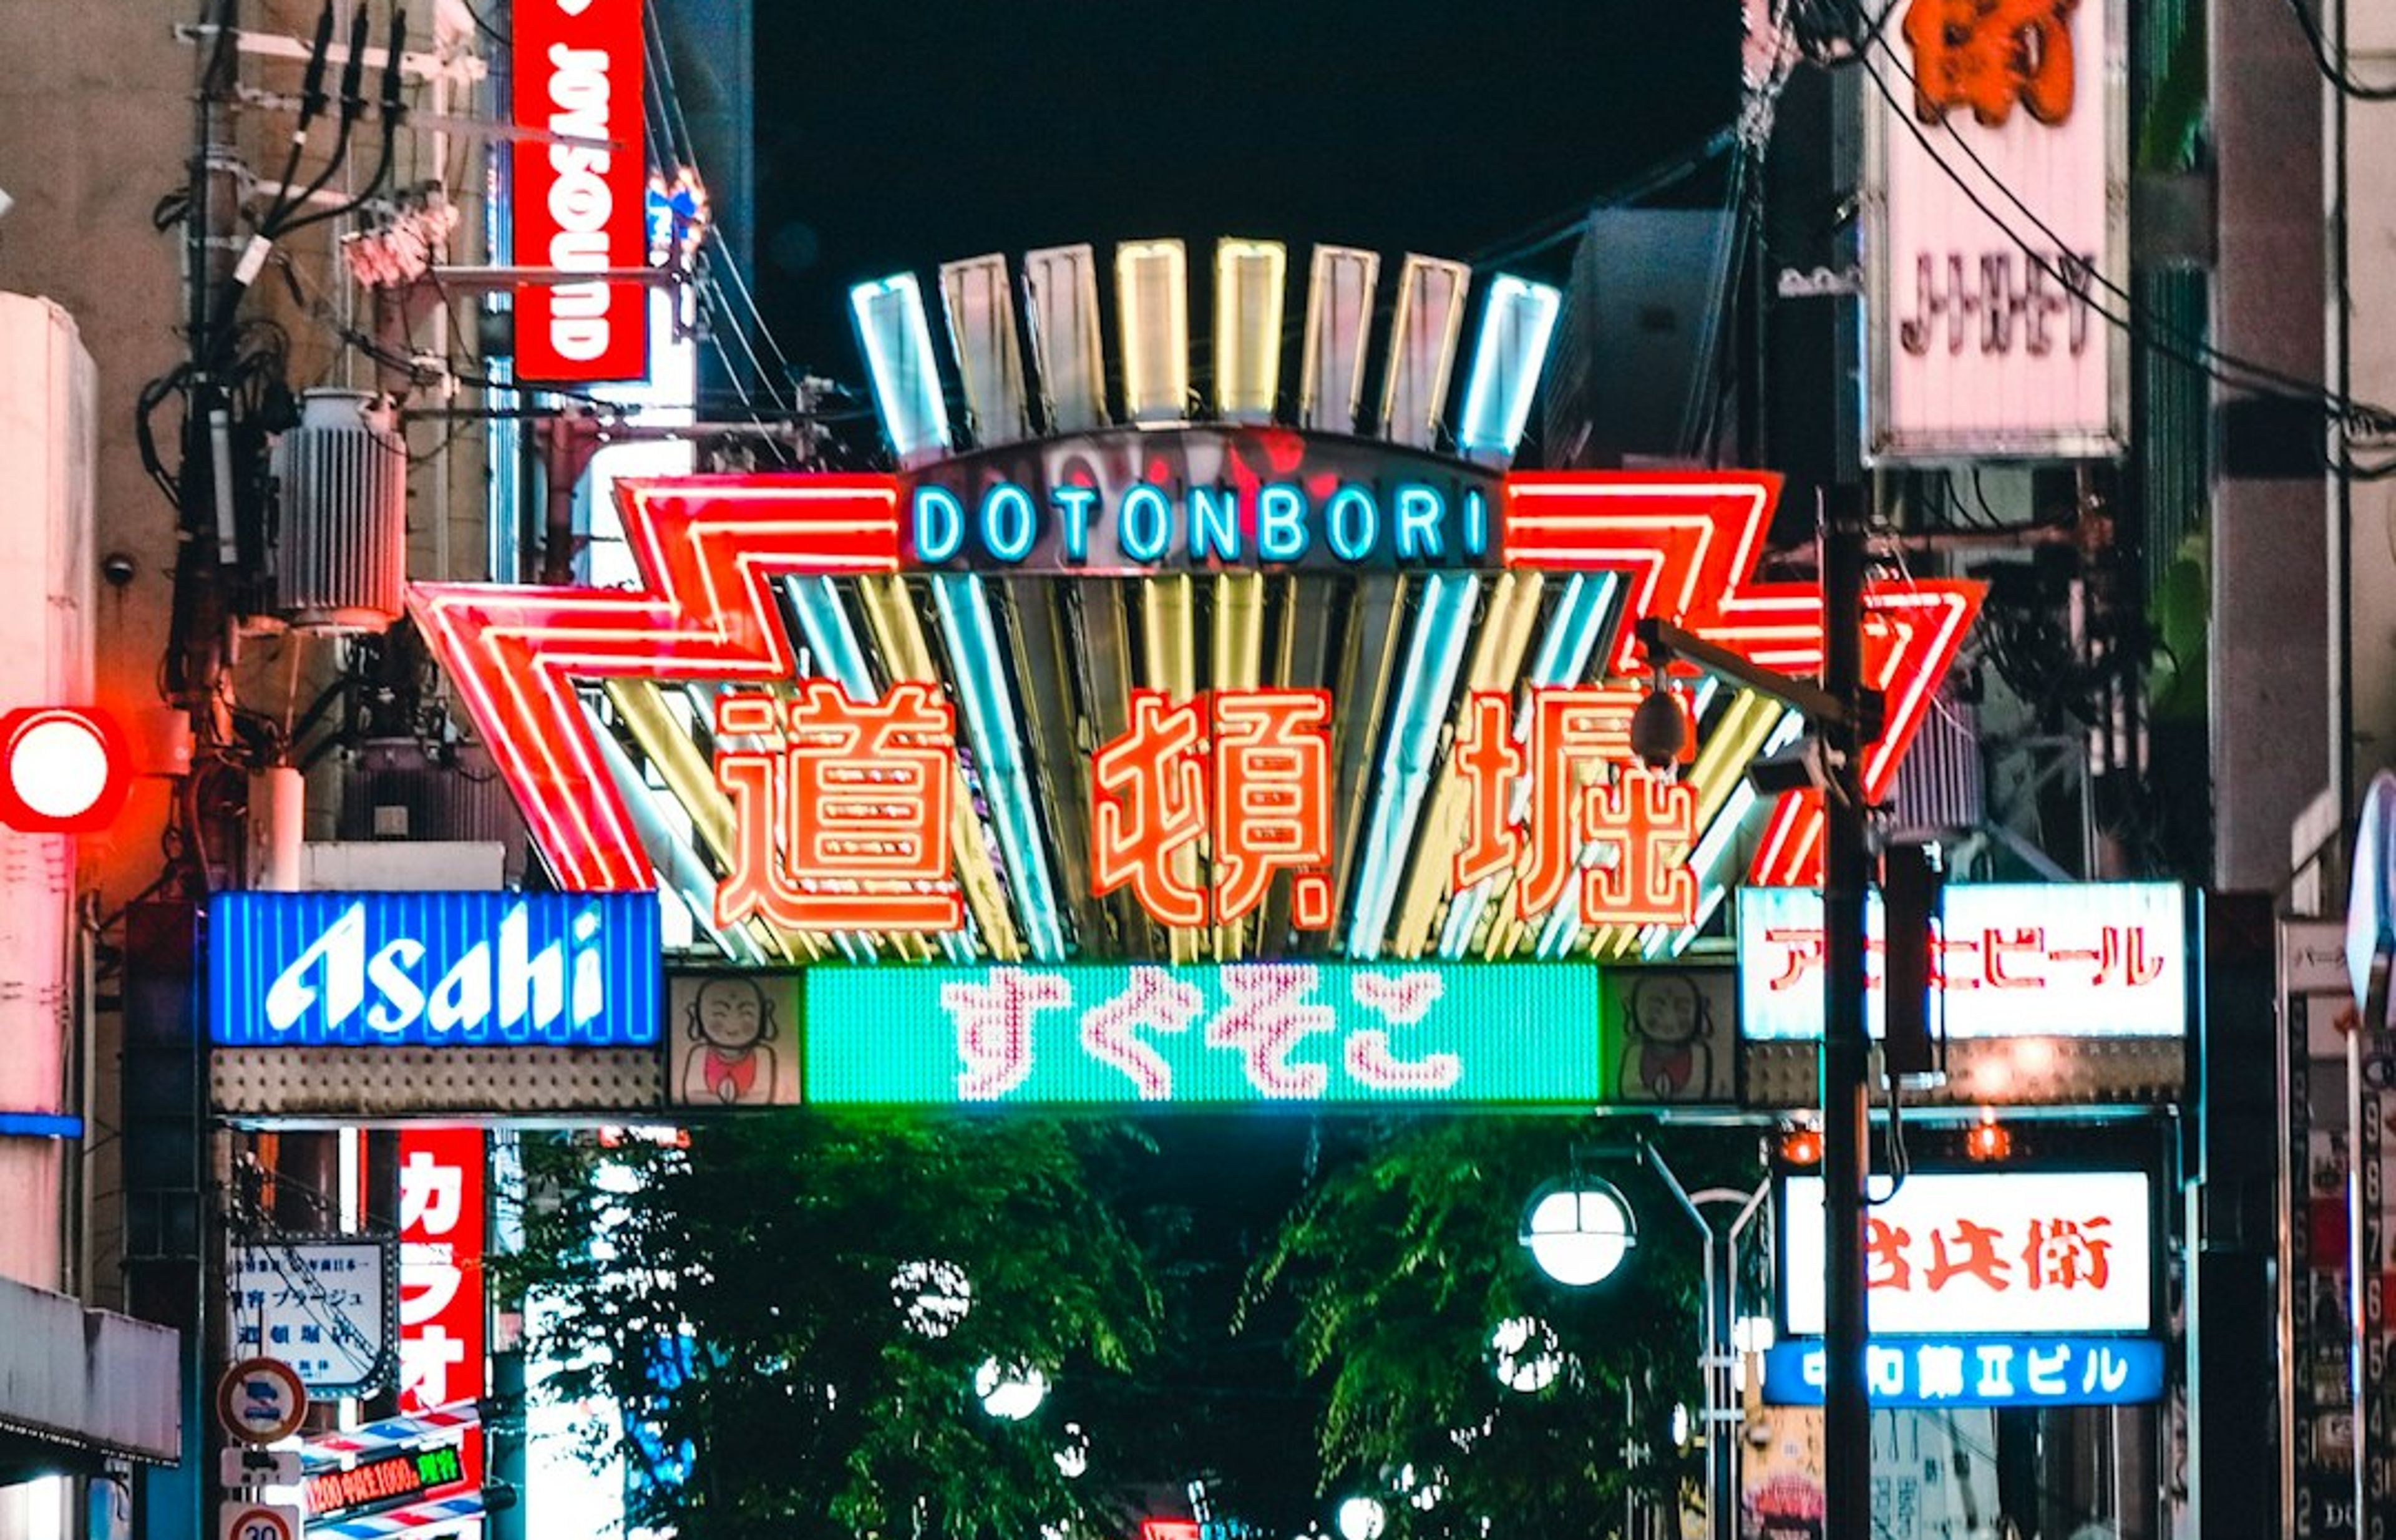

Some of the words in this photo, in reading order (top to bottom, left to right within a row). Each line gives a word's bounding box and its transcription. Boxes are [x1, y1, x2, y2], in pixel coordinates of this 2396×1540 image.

[548, 43, 612, 361] JOYSOUND
[913, 484, 1490, 563] DOTONBORI
[714, 682, 1698, 931] 道頓堀
[266, 900, 603, 1032] Asahi
[1766, 927, 2164, 991] アヒビール
[940, 966, 1461, 1101] すぐそこ
[2367, 1101, 2379, 1143] 9
[2367, 1161, 2380, 1202] 8
[2368, 1219, 2380, 1263] 7
[2368, 1278, 2382, 1322] 6
[2369, 1338, 2382, 1380] 5
[2370, 1396, 2383, 1435] 4
[2371, 1457, 2384, 1498] 3
[246, 1526, 276, 1540] 30
[2298, 1487, 2311, 1536] 2
